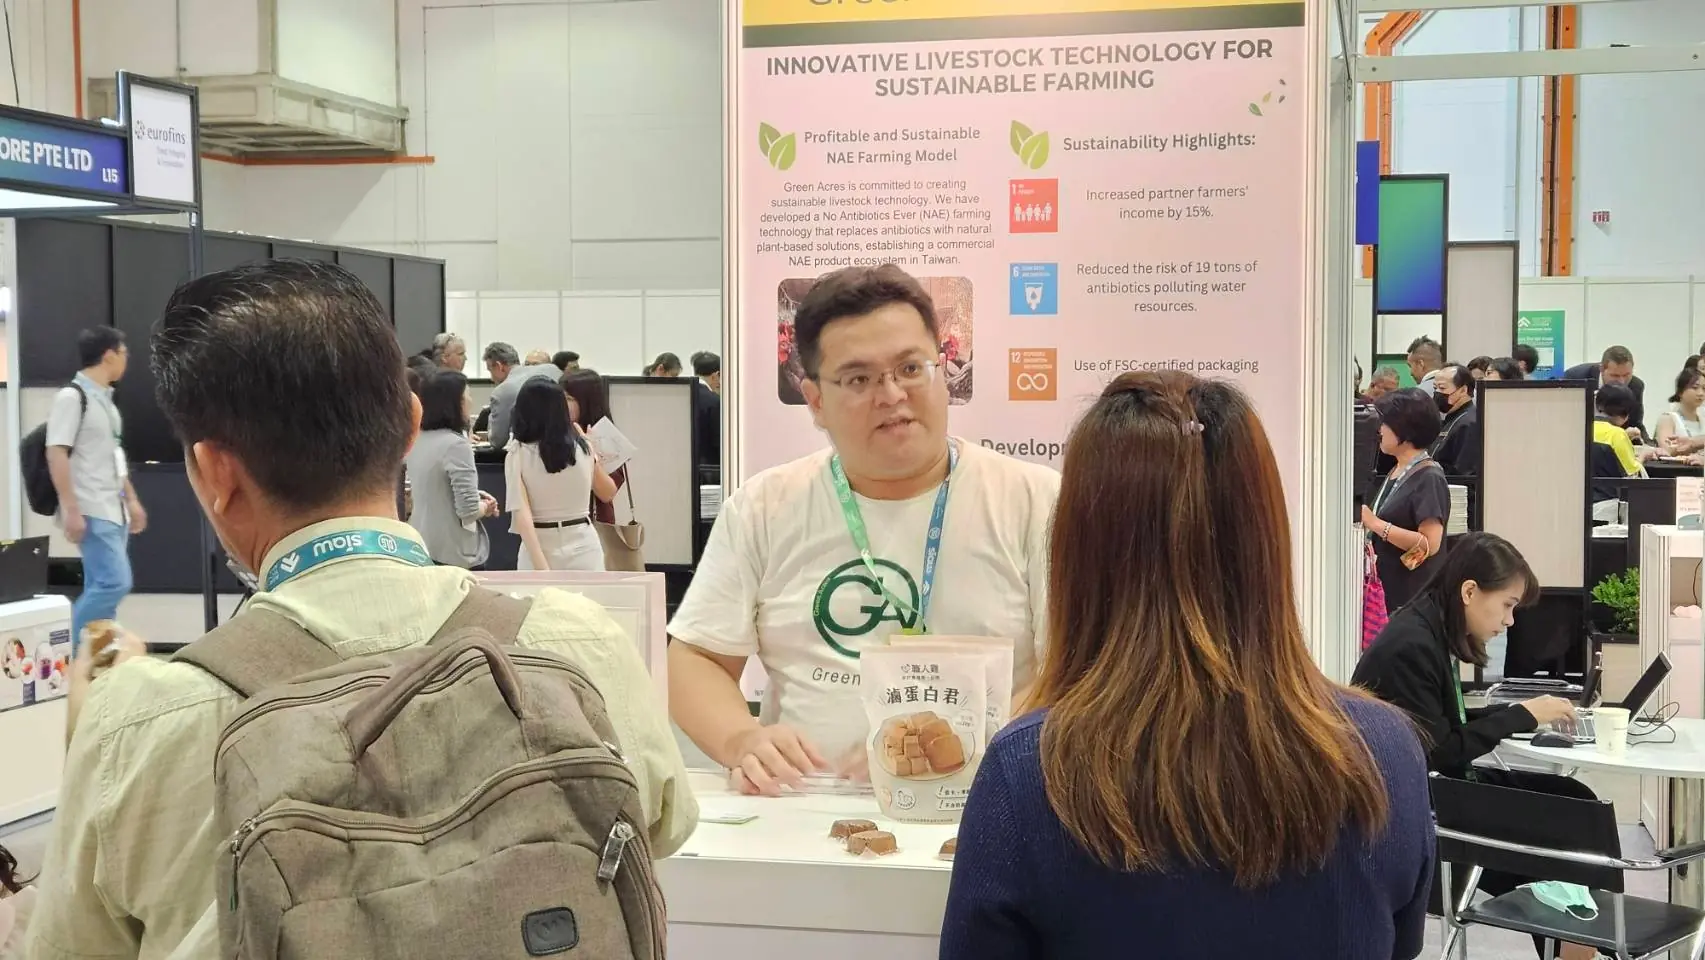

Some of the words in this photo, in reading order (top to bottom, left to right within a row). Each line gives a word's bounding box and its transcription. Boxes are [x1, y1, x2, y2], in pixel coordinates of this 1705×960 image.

[767, 53, 908, 76] INNOVATIVE
[916, 48, 1044, 71] LIVESTOCK
[1050, 41, 1216, 66] TECHNOLOGY
[1223, 39, 1273, 60] FOR
[875, 74, 1036, 96] SUSTAINABLE
[1044, 70, 1154, 92] FARMING
[147, 127, 186, 144] eurofins
[804, 130, 869, 143] Profitable
[874, 130, 897, 141] and
[902, 127, 980, 141] Sustainable
[1064, 134, 1168, 152] Sustainability
[1173, 132, 1255, 150] Highlights:
[33, 142, 62, 168] PTE
[64, 146, 92, 172] LTD
[827, 152, 854, 164] NAE
[858, 150, 911, 165] Farming
[916, 149, 956, 162] Model
[102, 168, 119, 184] L15
[784, 182, 814, 192] Green
[817, 182, 845, 192] Acres
[848, 182, 856, 191] is
[859, 181, 910, 191] committed
[914, 181, 923, 190] to
[926, 180, 966, 190] creating
[1086, 188, 1144, 200] Increased
[1149, 188, 1193, 202] partner
[1198, 185, 1249, 198] farmers'
[771, 197, 826, 207] sustainable
[829, 196, 872, 206] livestock
[875, 195, 931, 207] technology.
[934, 194, 951, 204] We
[955, 194, 979, 203] have
[760, 213, 810, 223] developed
[822, 212, 836, 221] No
[840, 211, 890, 221] Antibiotics
[893, 211, 916, 220] Ever
[919, 210, 950, 222] (NAE)
[953, 209, 990, 220] farming
[1119, 207, 1164, 218] income
[1167, 206, 1182, 220] by
[1185, 205, 1213, 217] 15%.
[760, 227, 812, 238] technology
[815, 227, 833, 236] that
[836, 226, 878, 238] replaces
[881, 225, 931, 235] antibiotics
[934, 224, 954, 234] with
[957, 224, 992, 234] natural
[757, 242, 813, 253] plant-based
[816, 241, 862, 252] solutions,
[866, 240, 924, 252] establishing
[937, 239, 994, 249] commercial
[789, 256, 811, 266] NAE
[814, 256, 850, 268] product
[854, 256, 907, 267] ecosystem
[910, 255, 918, 264] in
[922, 254, 960, 264] Taiwan.
[1077, 263, 1129, 275] Reduced
[1132, 263, 1152, 274] the
[1156, 262, 1176, 274] risk
[1180, 262, 1192, 273] of
[1196, 262, 1210, 273] 19
[1214, 262, 1240, 272] tons
[1244, 260, 1258, 272] of
[1013, 267, 1020, 278] 6
[1087, 282, 1150, 294] antibiotics
[1153, 281, 1208, 296] polluting
[1211, 281, 1246, 292] water
[1134, 301, 1197, 312] resources.
[1011, 352, 1021, 363] 12
[1074, 360, 1095, 371] Use
[1099, 359, 1112, 371] of
[1115, 359, 1194, 371] FSC-certified
[1198, 358, 1258, 373] packaging
[980, 438, 1066, 460] Develop
[812, 668, 861, 685] Green
[886, 686, 960, 704] 滷蛋白君
